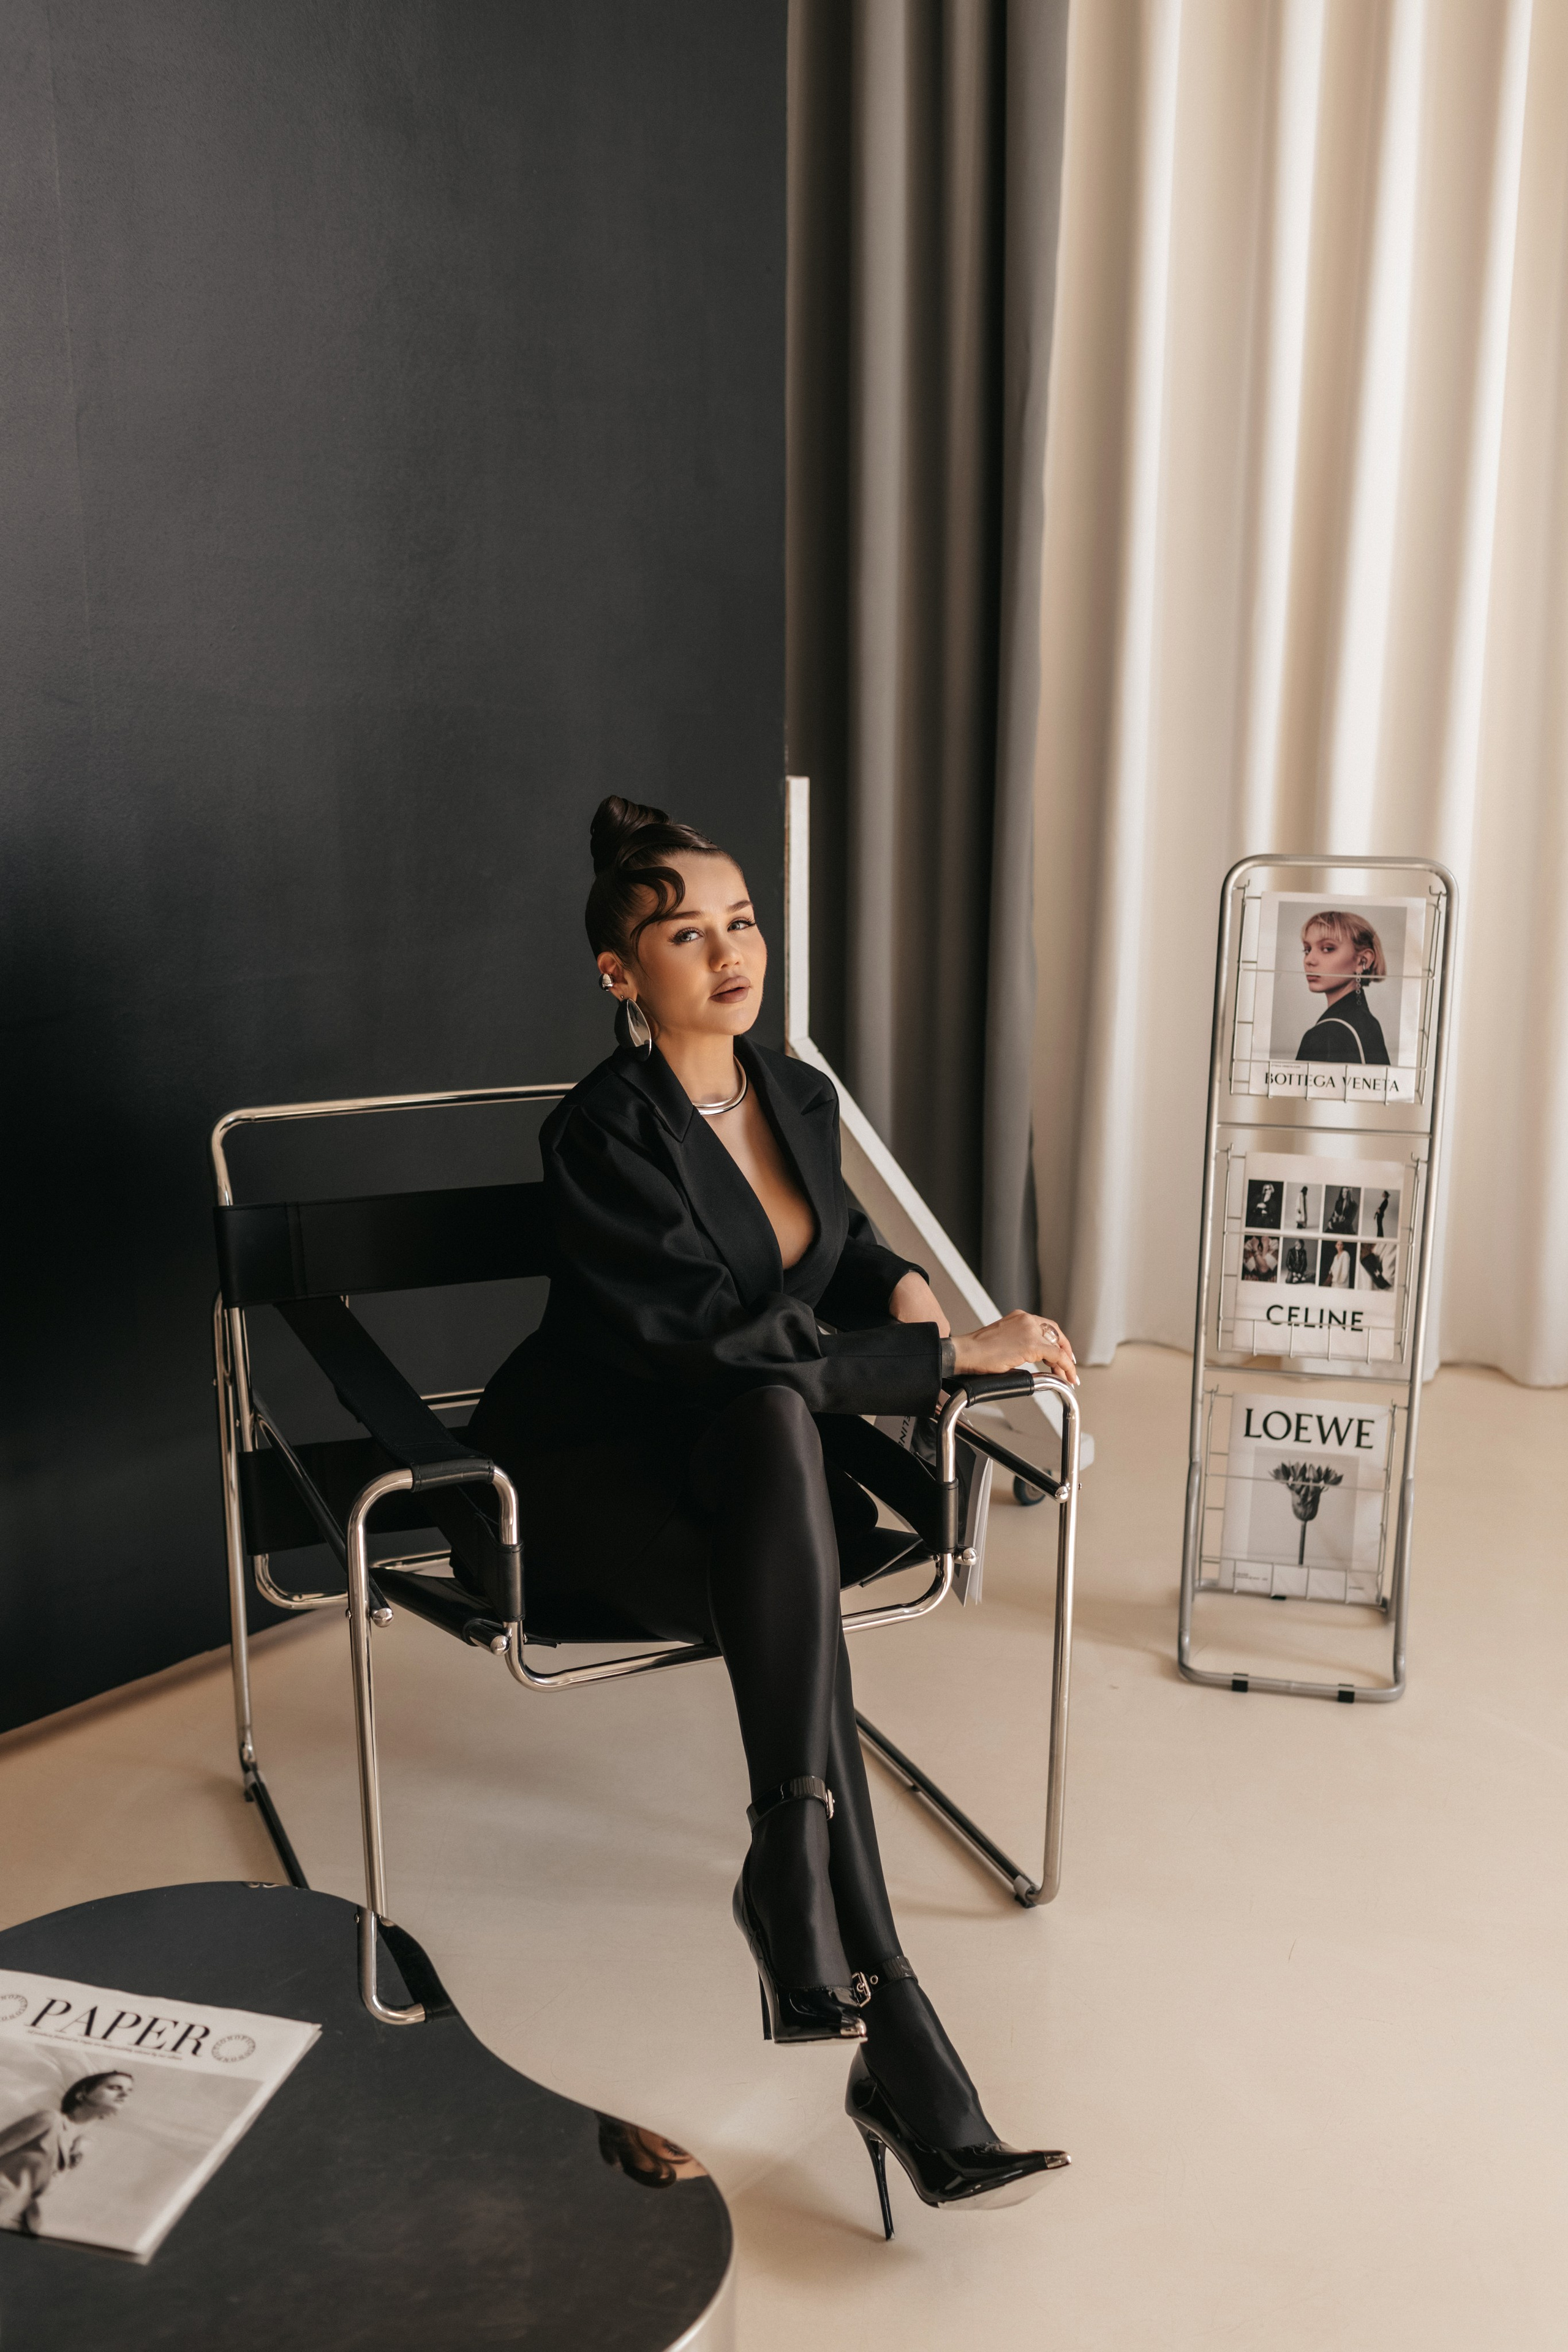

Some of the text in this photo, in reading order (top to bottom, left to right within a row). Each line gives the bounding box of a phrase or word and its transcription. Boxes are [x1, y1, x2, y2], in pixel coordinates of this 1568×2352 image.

[1265, 1072, 1400, 1092] BOTTEGA VENETA
[1265, 1304, 1364, 1332] CELINE
[1243, 1408, 1375, 1450] LOEWE
[24, 1997, 211, 2057] PAPER
